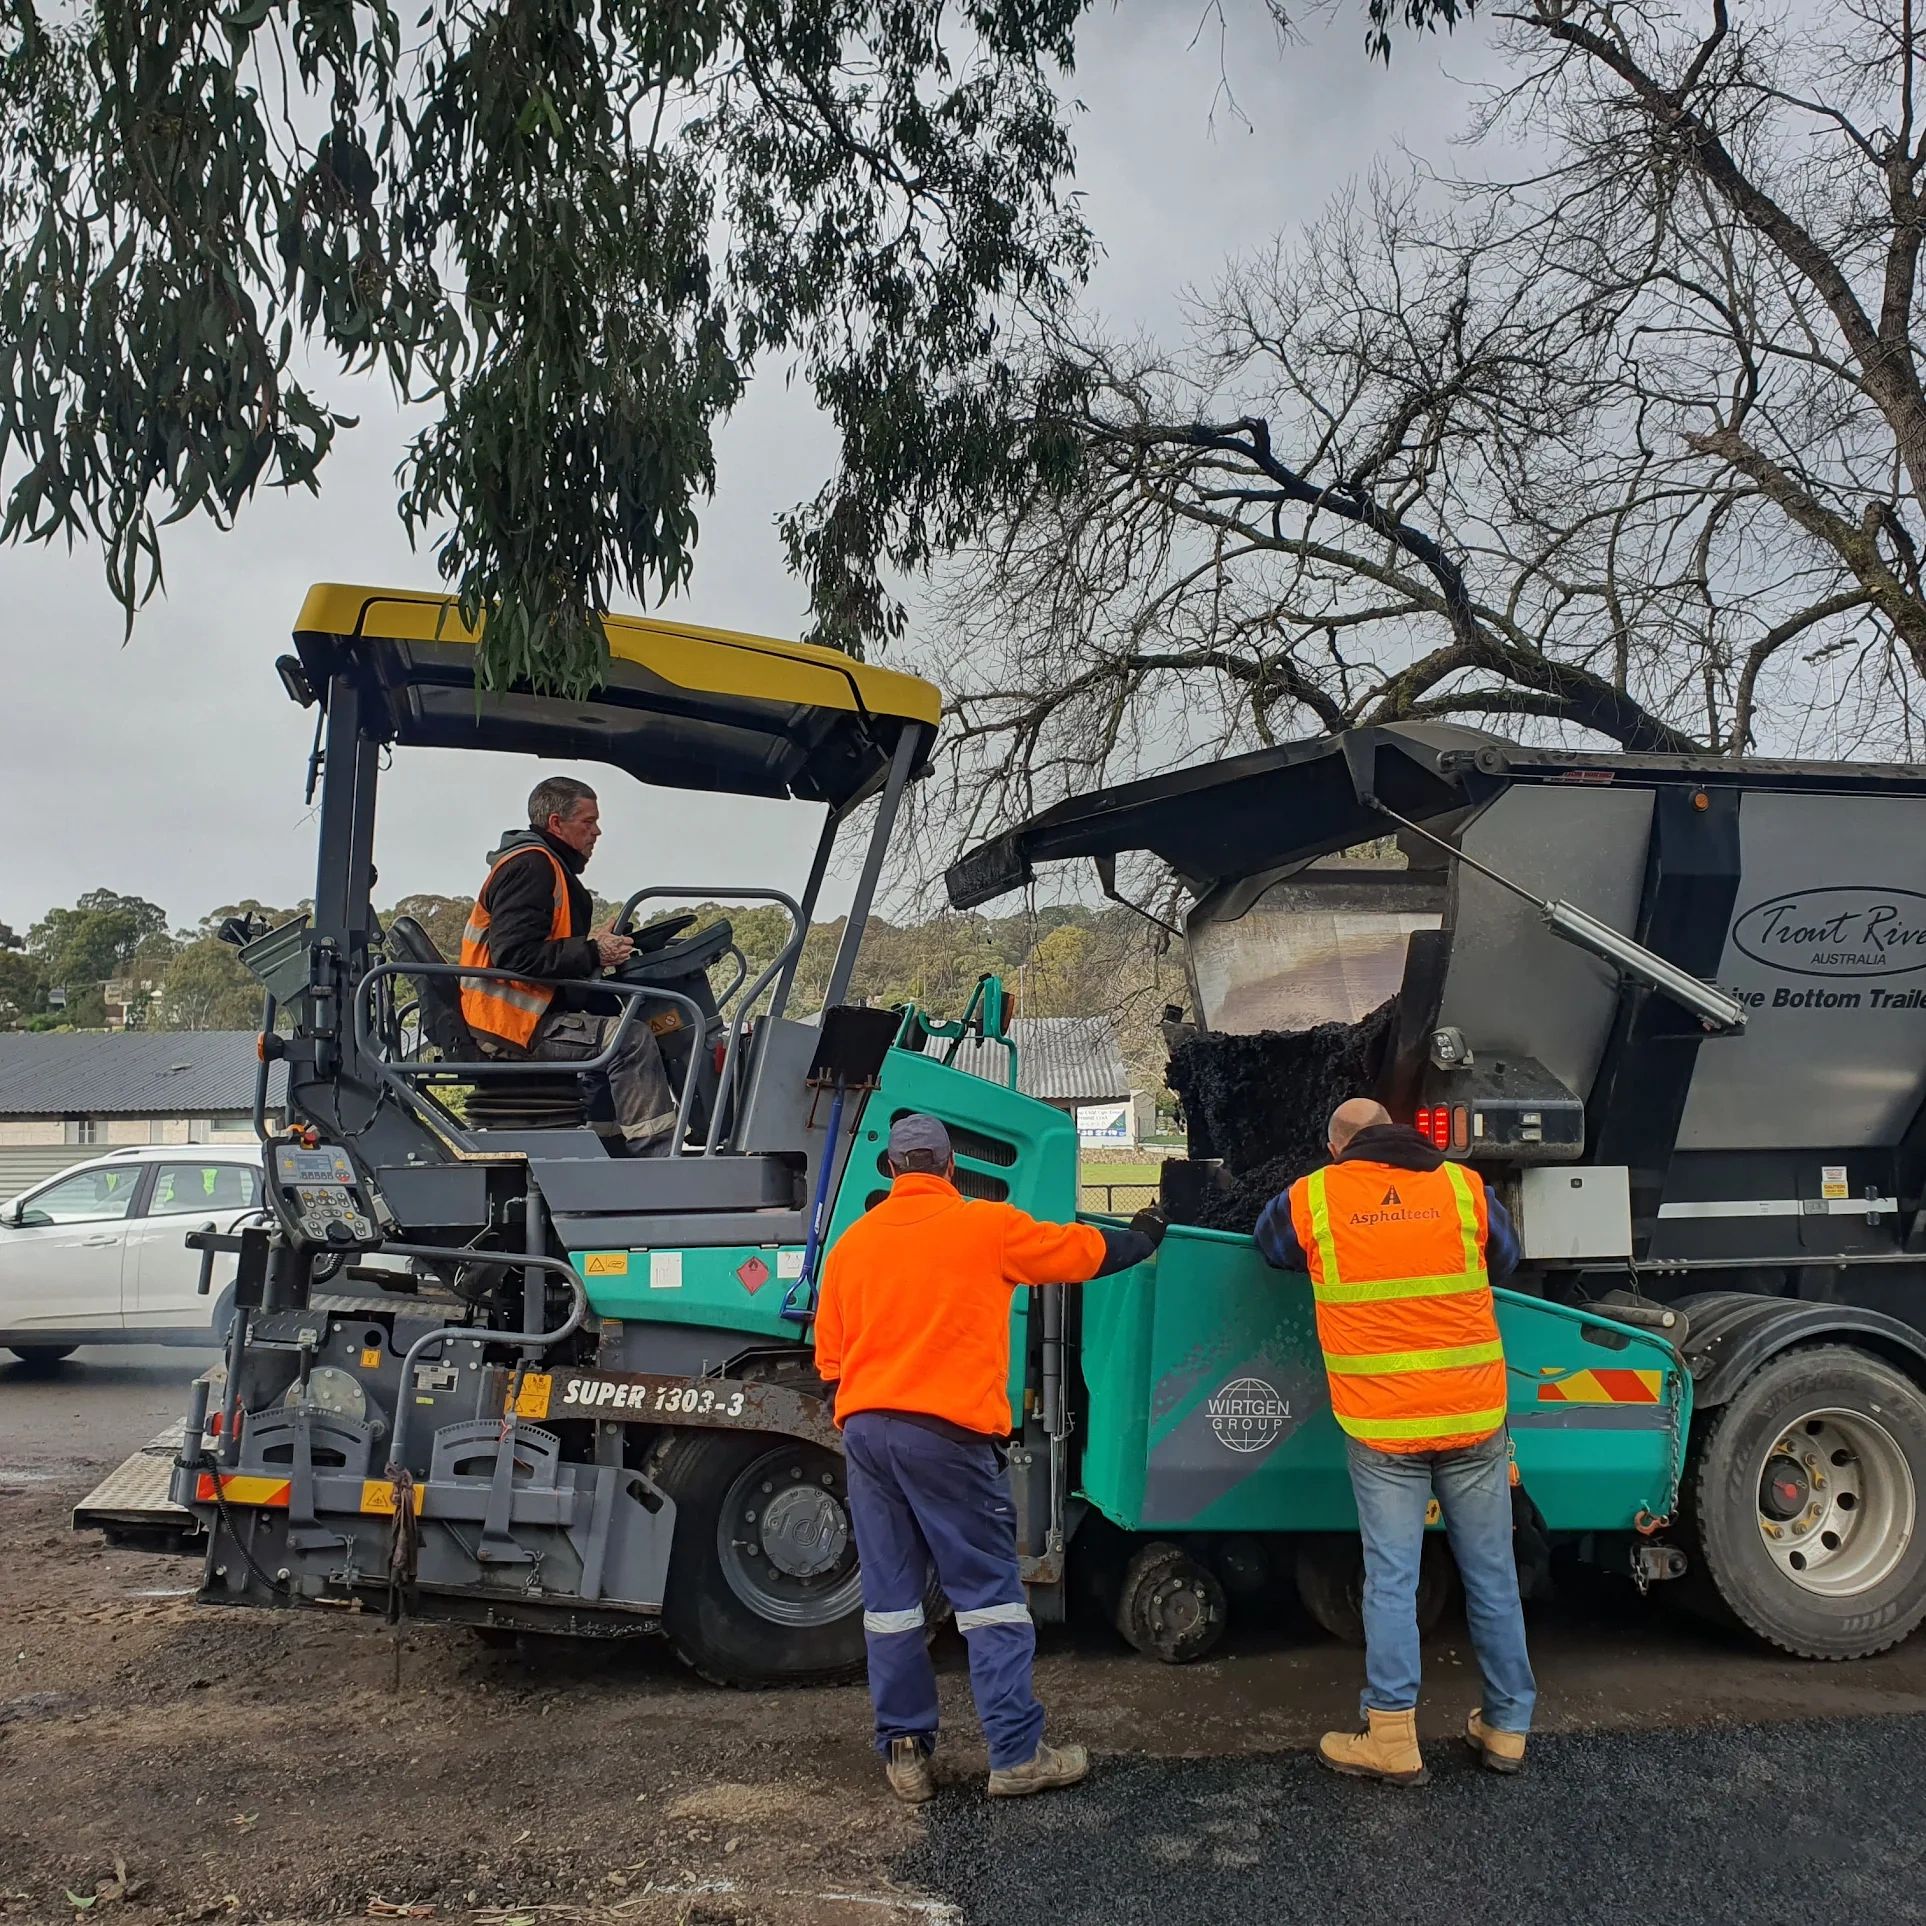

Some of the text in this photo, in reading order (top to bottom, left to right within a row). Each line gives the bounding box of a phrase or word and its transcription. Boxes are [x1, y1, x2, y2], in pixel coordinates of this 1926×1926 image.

[1761, 904, 1862, 944] Trout
[1810, 953, 1887, 966] AUSTRALIA
[1727, 986, 1766, 1008] ve
[1772, 987, 1861, 1009] Bottom
[1349, 1207, 1441, 1225] Asphaltech
[563, 1379, 745, 1417] SUPER 1303-3
[1208, 1399, 1290, 1416] WIRTGEN
[1212, 1418, 1283, 1431] GROUP
